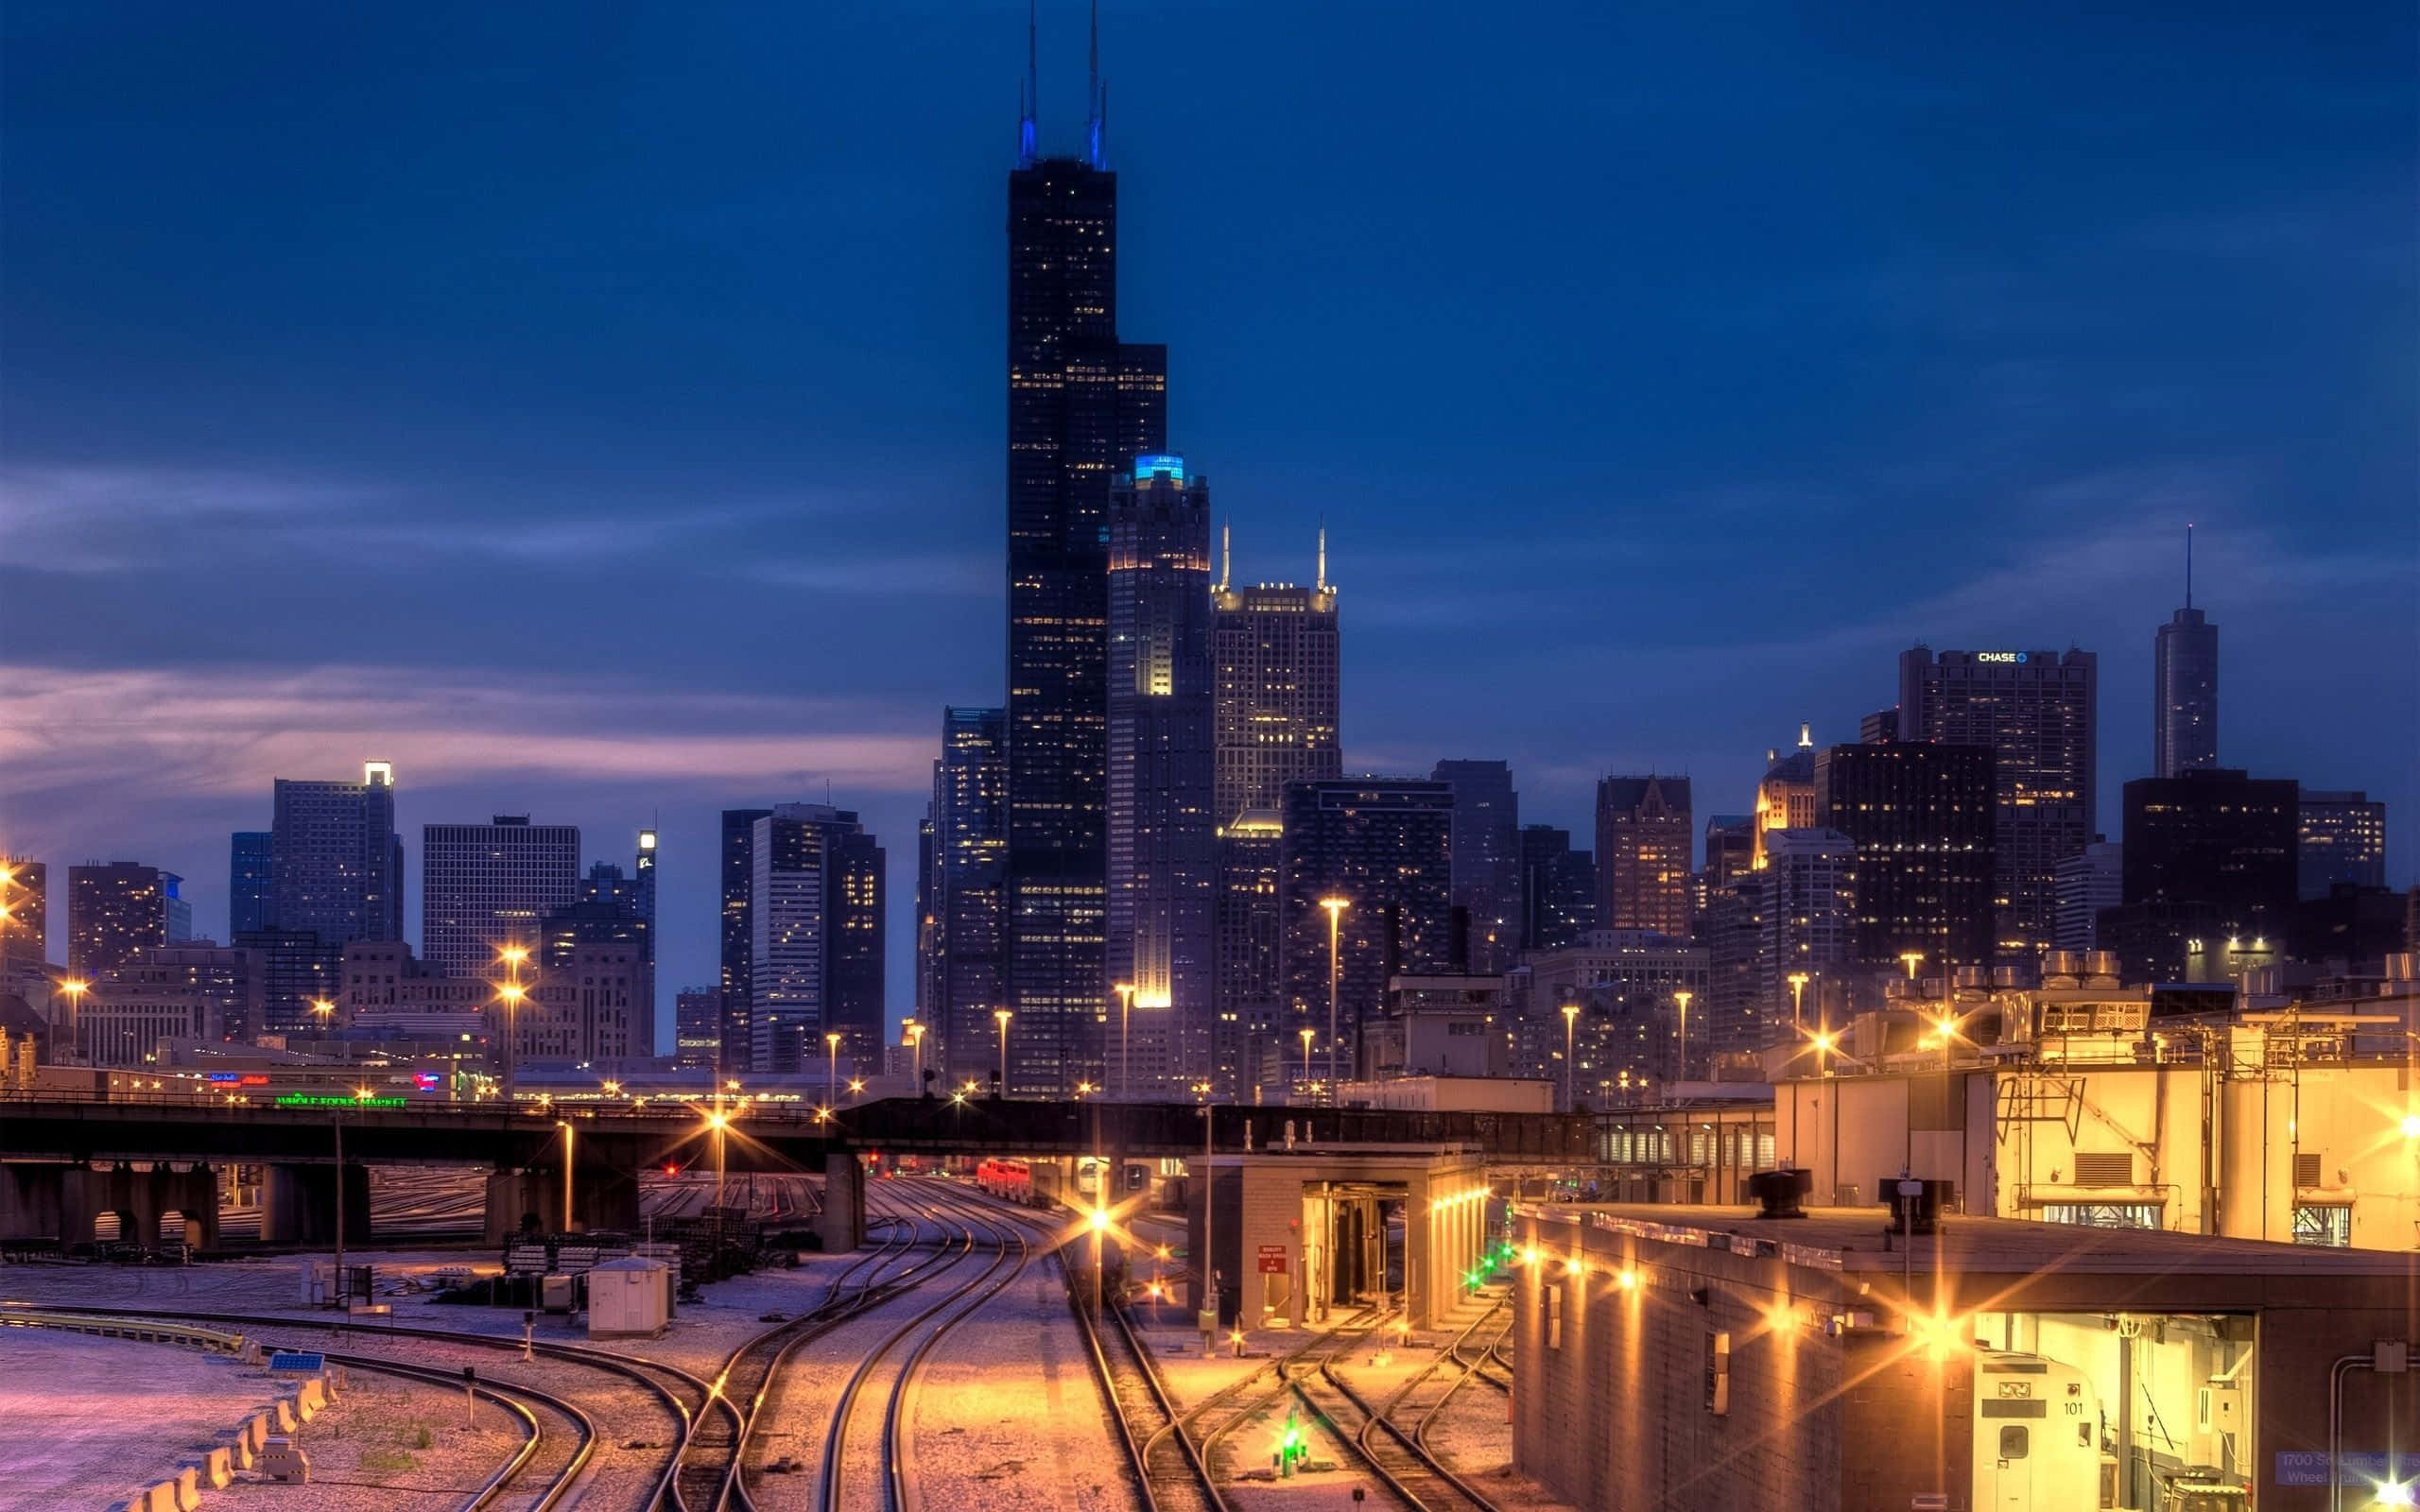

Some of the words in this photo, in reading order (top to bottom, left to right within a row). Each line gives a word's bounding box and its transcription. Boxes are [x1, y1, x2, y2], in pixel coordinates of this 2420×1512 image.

[1979, 652, 2016, 662] CHASE
[275, 1093, 318, 1106] WHOLE
[320, 1096, 357, 1107] FOODS
[359, 1097, 407, 1108] MARKET
[2065, 1402, 2083, 1415] 101
[2283, 1453, 2312, 1466] 1700
[2287, 1470, 2327, 1484] Wheel
